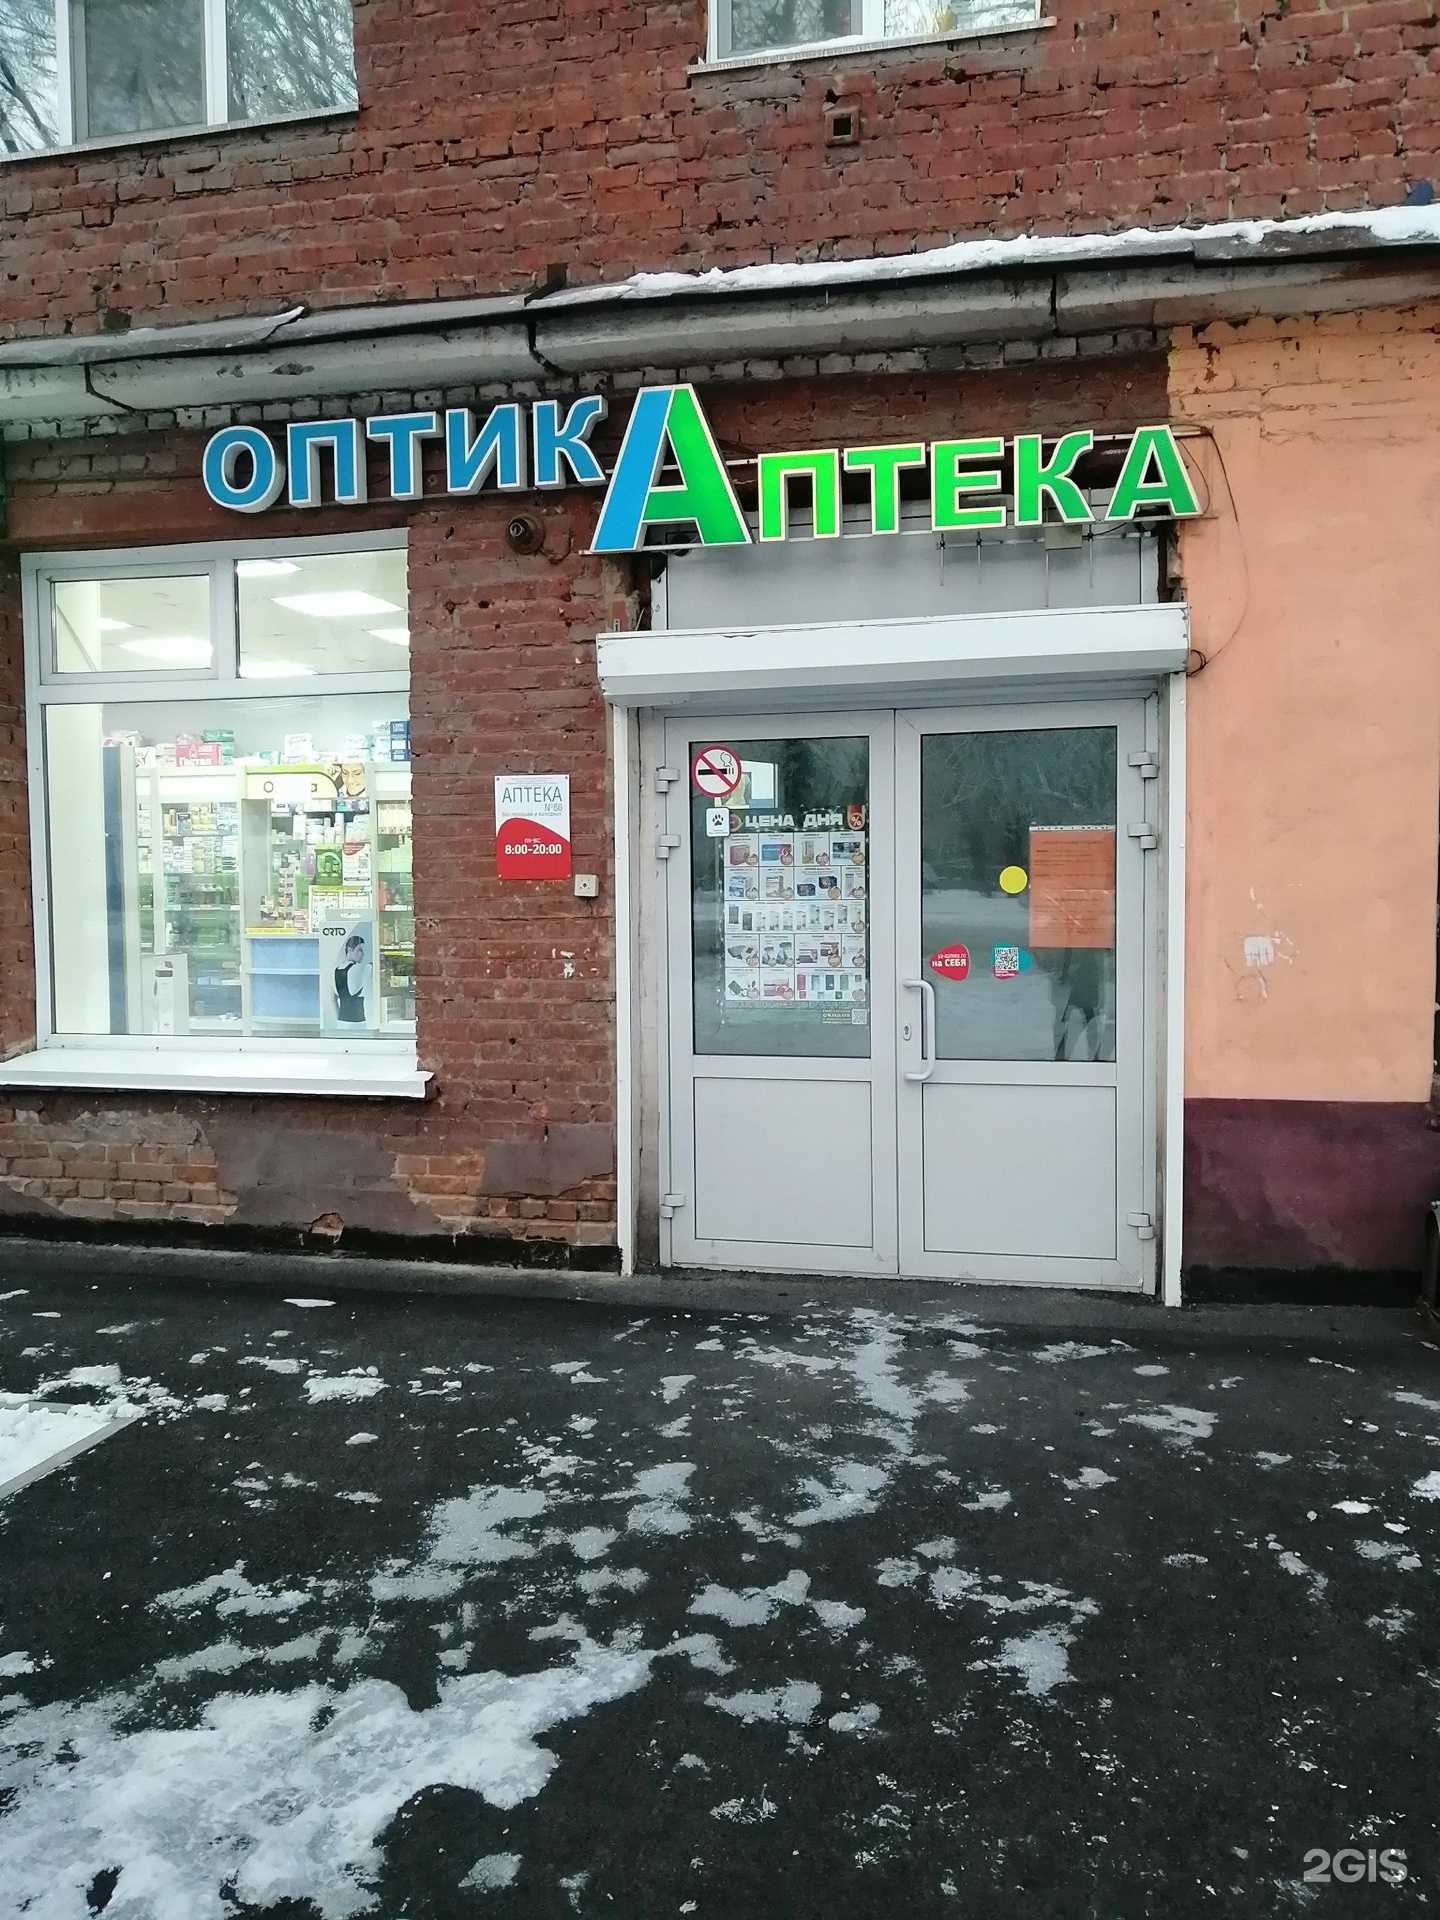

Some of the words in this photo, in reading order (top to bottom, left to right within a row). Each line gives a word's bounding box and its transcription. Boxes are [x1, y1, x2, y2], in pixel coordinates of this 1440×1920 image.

[502, 786, 563, 803] АПТЕКА
[745, 814, 795, 828] ЦЕНА
[803, 812, 843, 828] ДНЯ
[504, 844, 562, 855] 8:00-20:00
[945, 958, 967, 967] СЕБЯ
